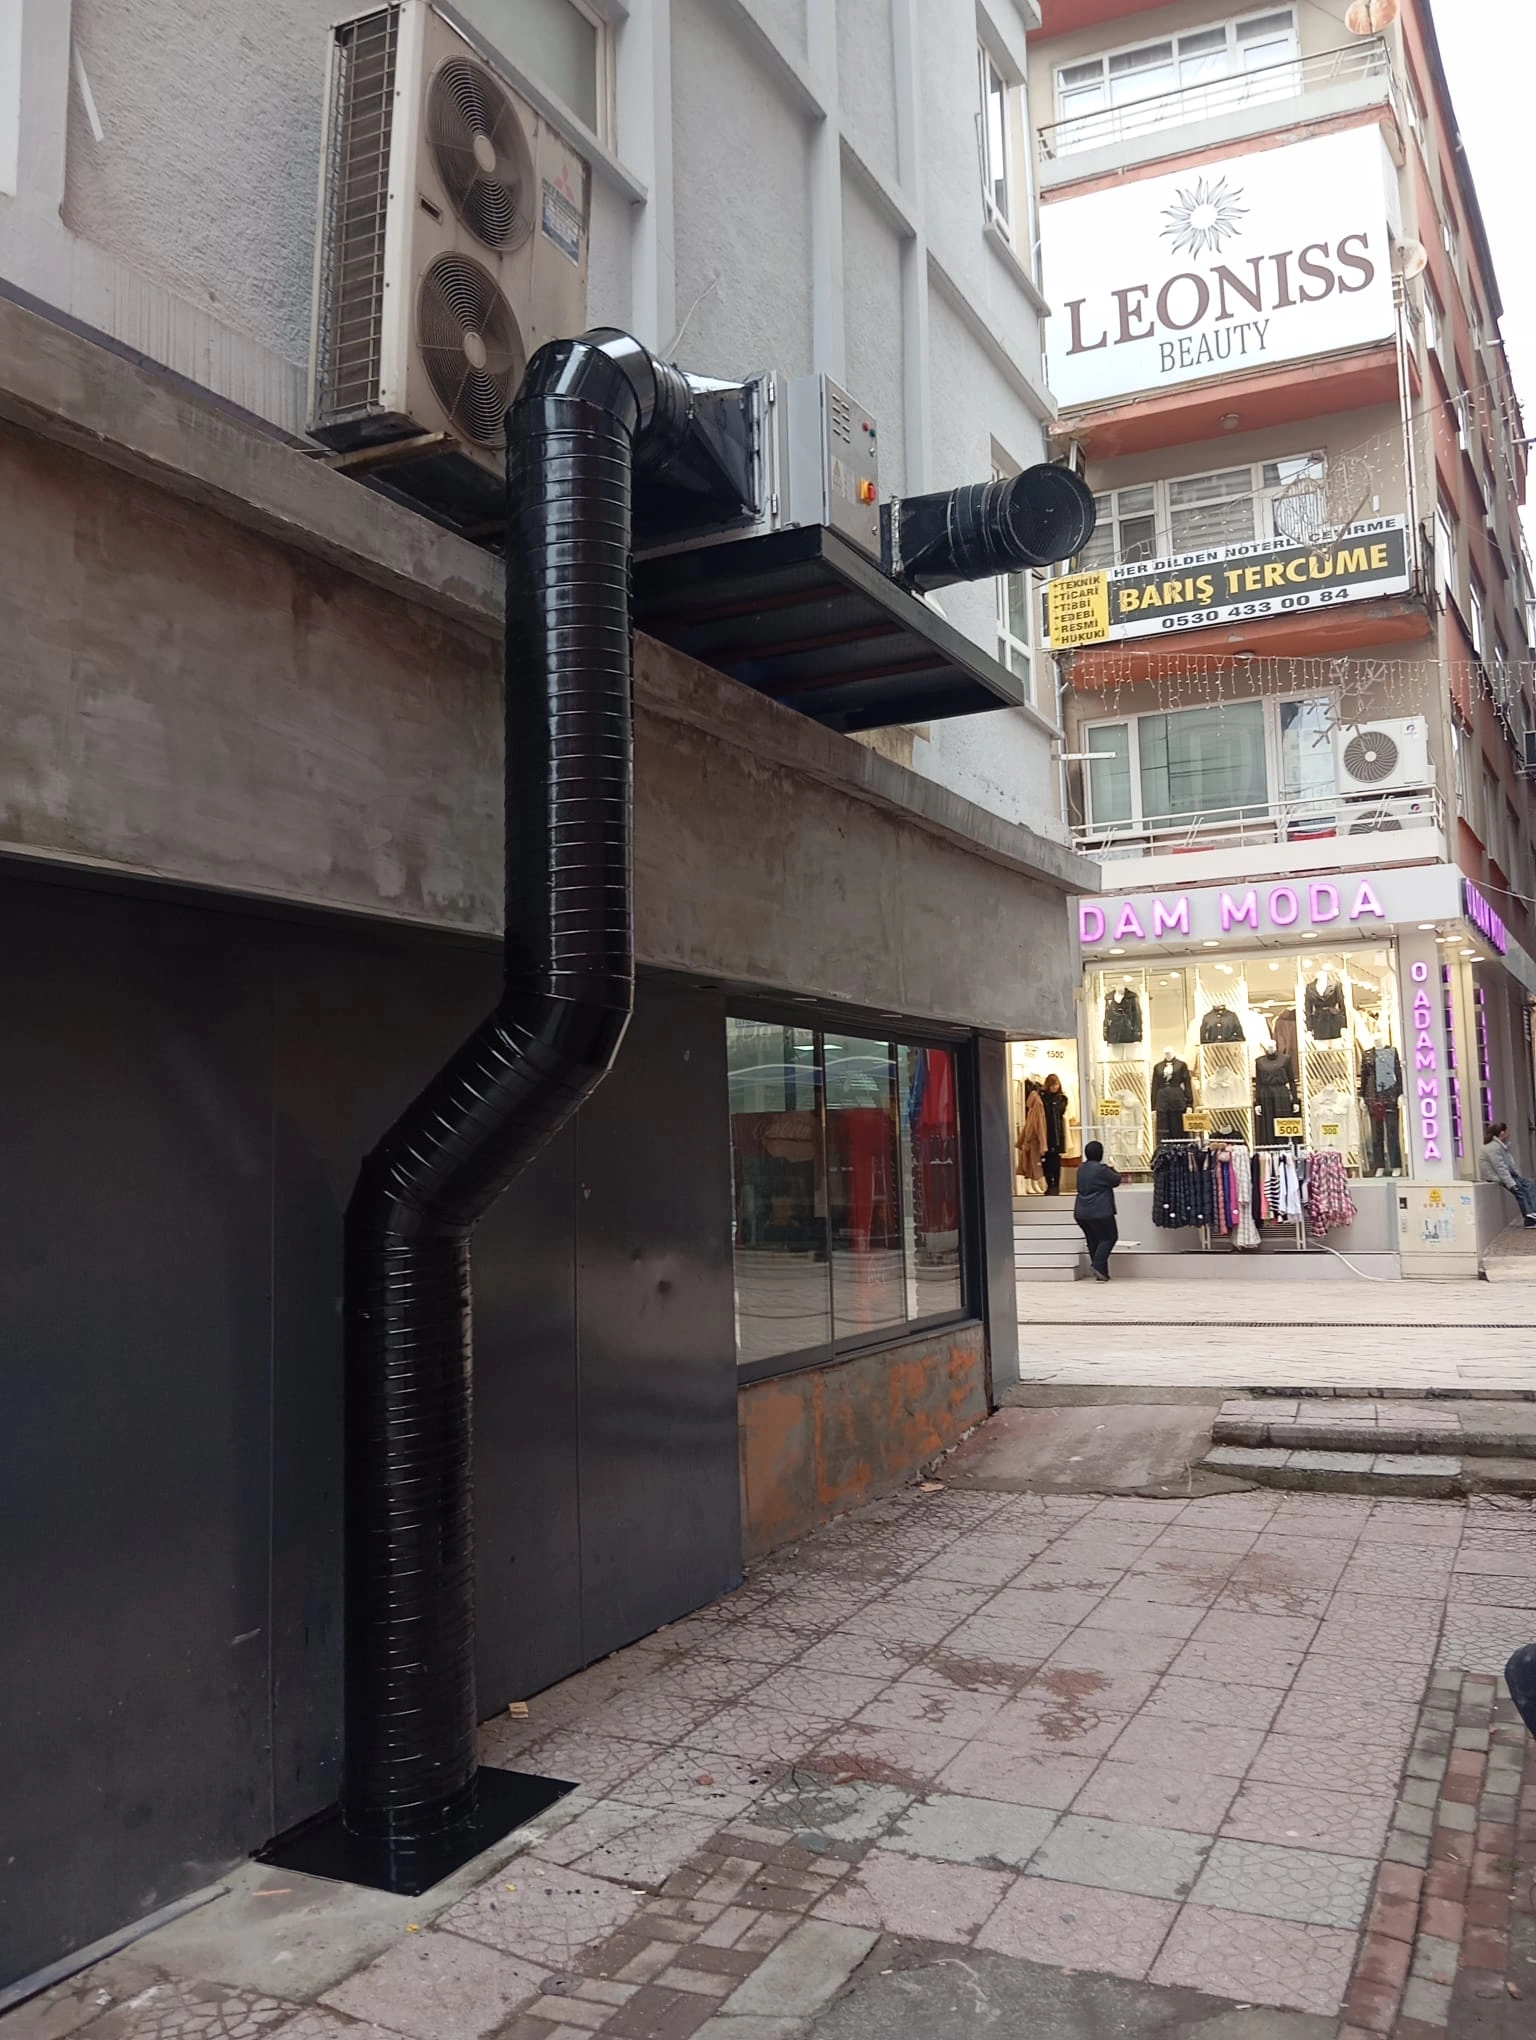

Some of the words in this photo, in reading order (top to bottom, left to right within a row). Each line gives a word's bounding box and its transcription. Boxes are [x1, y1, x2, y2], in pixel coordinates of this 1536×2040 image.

[1064, 233, 1375, 356] LEONISS
[1159, 319, 1270, 373] BEAUTY
[1114, 565, 1147, 578] HER
[1154, 551, 1218, 571] DİLDEN
[1119, 575, 1214, 613] BARIŞ
[1224, 543, 1388, 594] TERCÜME
[1162, 610, 1219, 628] 0530
[1228, 601, 1272, 617] 433
[1281, 595, 1310, 609] 00
[1320, 588, 1350, 602] 84
[1220, 880, 1384, 932] MODA
[1414, 989, 1437, 1071] ADAM
[1279, 1126, 1298, 1135] 500
[1417, 1077, 1441, 1161] MODA
